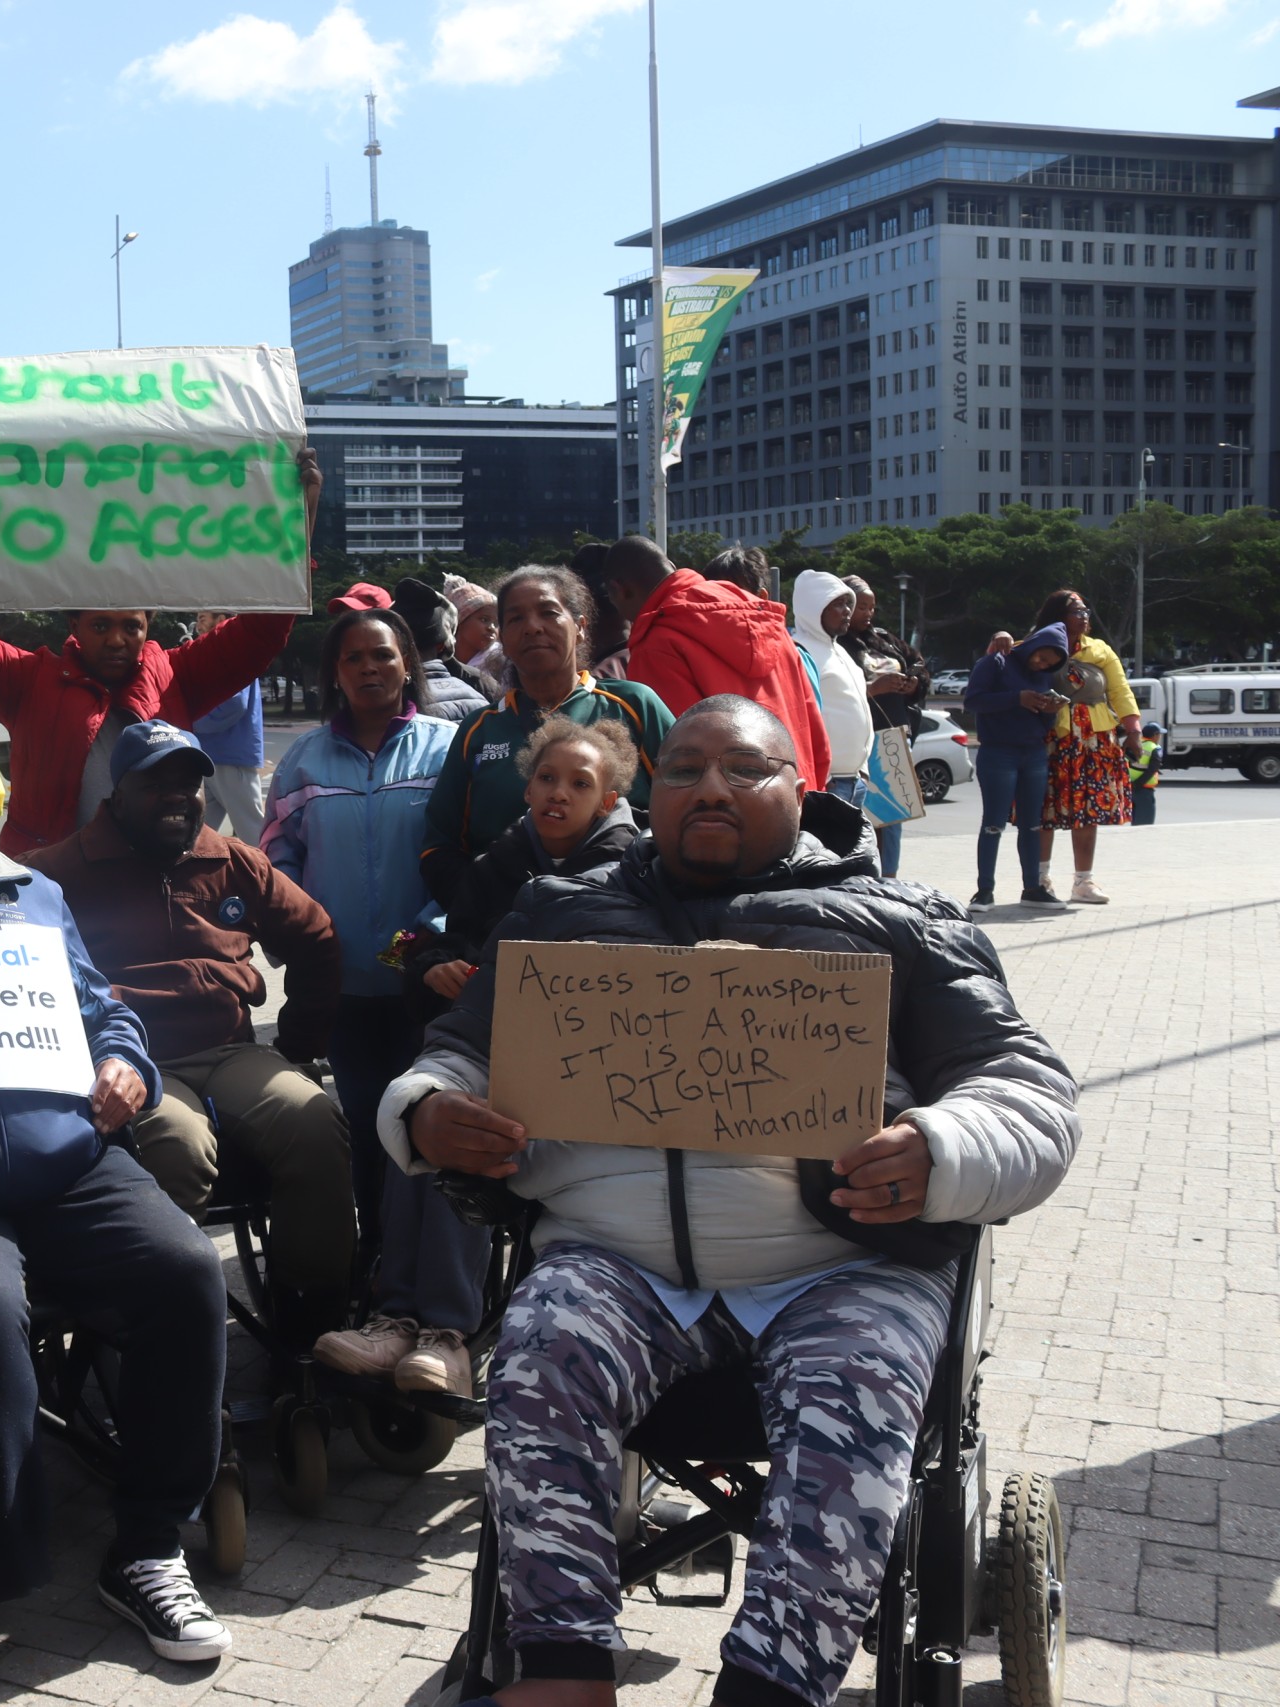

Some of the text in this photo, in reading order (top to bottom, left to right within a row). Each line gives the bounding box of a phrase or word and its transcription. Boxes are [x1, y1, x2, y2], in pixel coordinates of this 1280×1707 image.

[305, 406, 320, 417] YX
[953, 371, 968, 424] Auto
[483, 742, 510, 750] RUGBY
[1199, 727, 1249, 737] ELECTRICAL
[882, 729, 914, 816] EQUALITY
[518, 954, 634, 1000] Access
[701, 1007, 728, 1041] A
[740, 1008, 873, 1053] Privilage
[560, 1043, 616, 1080] IT
[698, 1047, 789, 1081] OUR
[605, 1069, 775, 1125] RIGHT
[713, 1086, 876, 1142] Amandla!!
